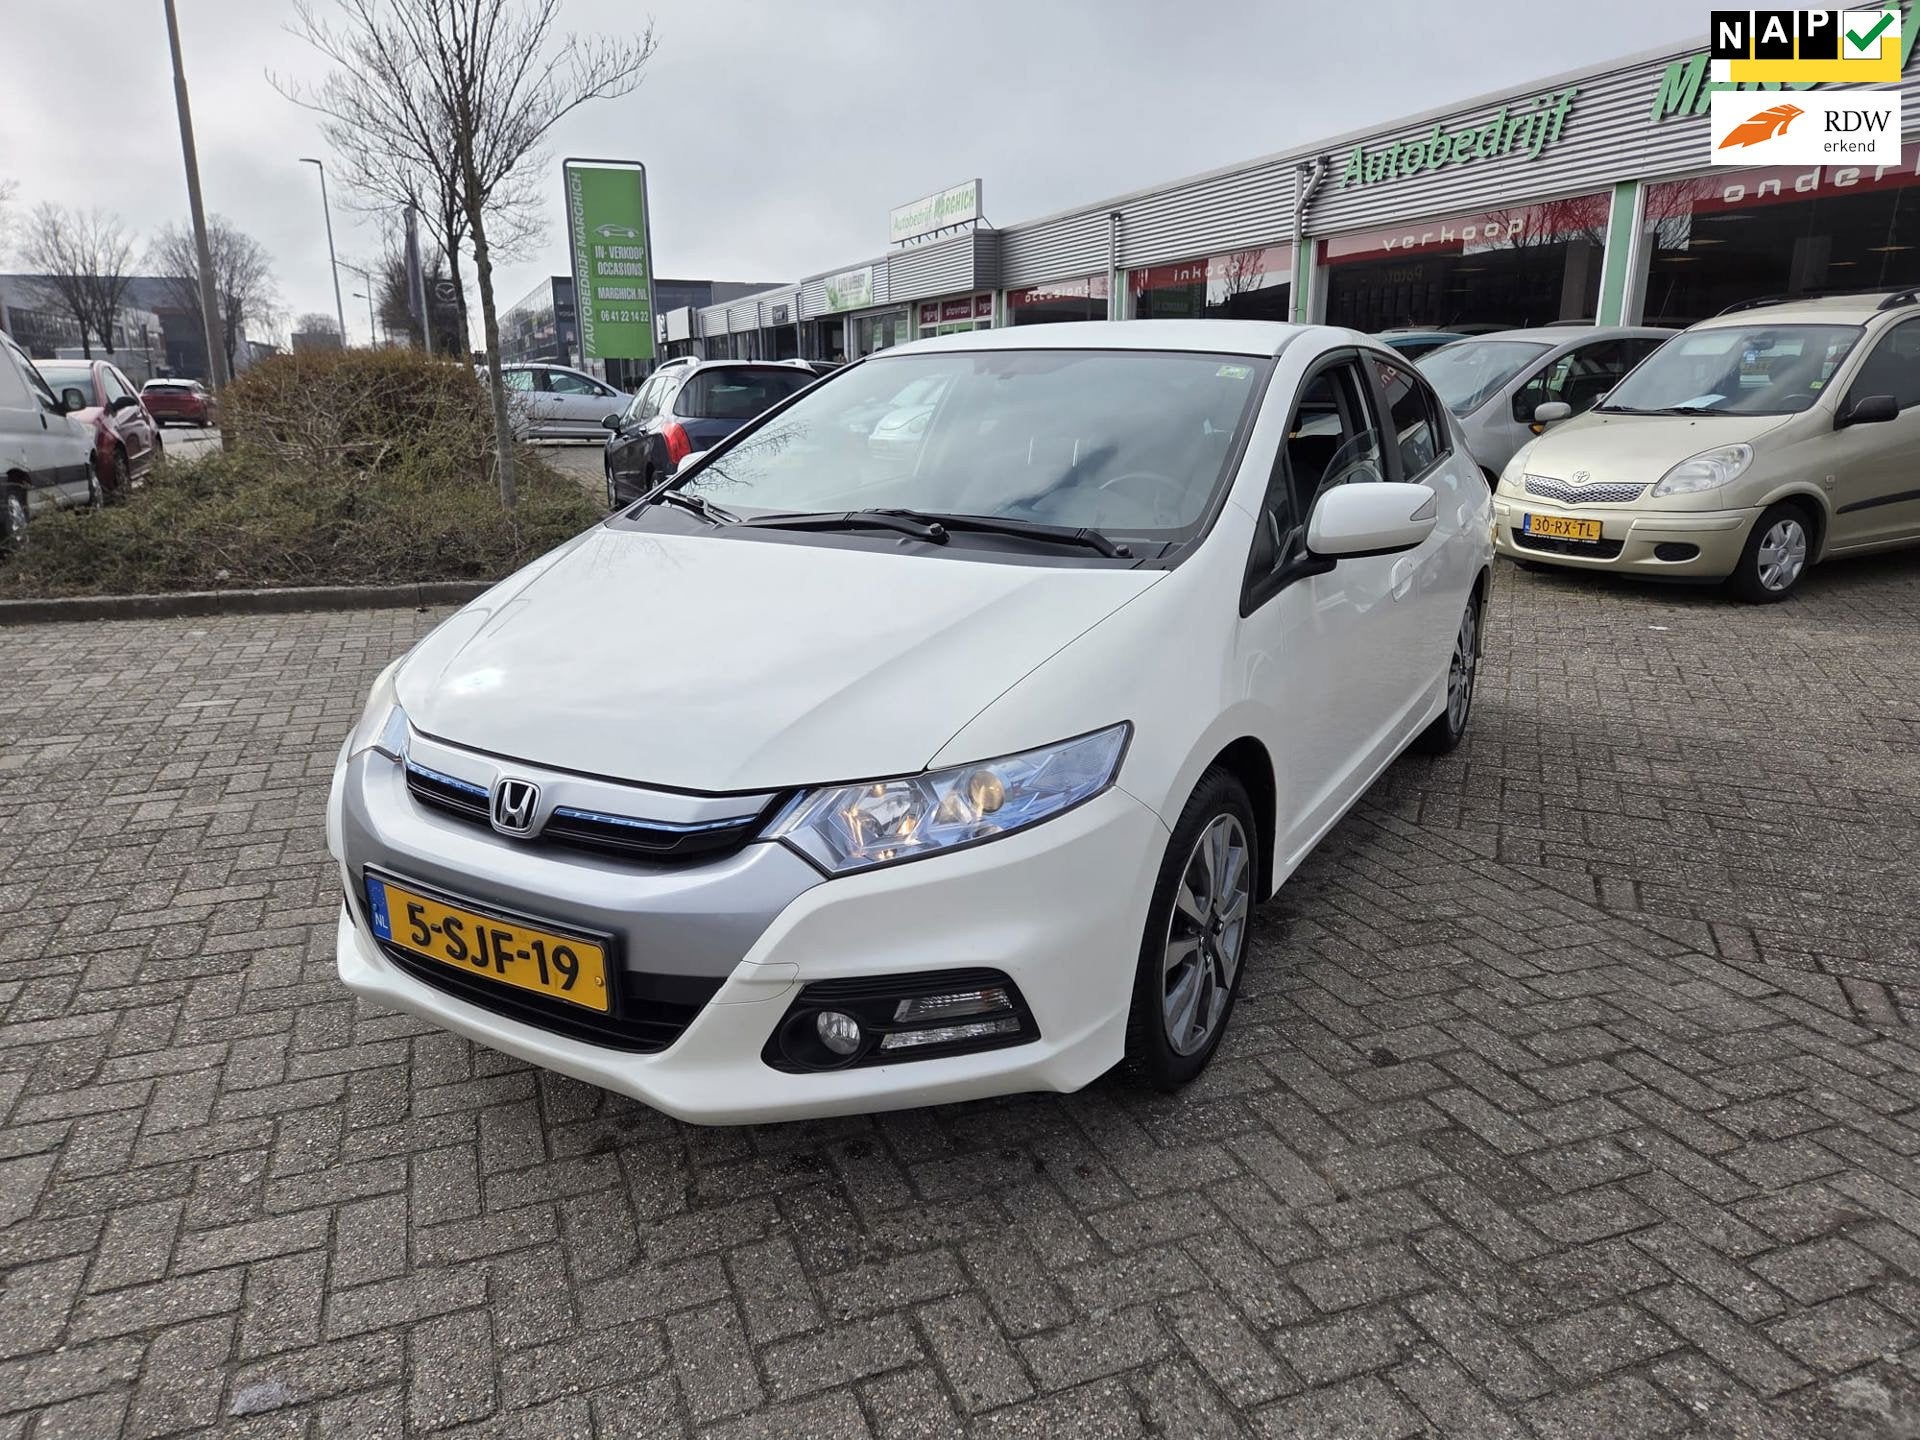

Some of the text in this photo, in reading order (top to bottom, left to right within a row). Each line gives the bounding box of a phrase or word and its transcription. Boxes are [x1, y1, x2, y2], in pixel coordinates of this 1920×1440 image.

[1337, 86, 1580, 189] Autobedrijf
[570, 171, 585, 248] MARGHICH
[1382, 217, 1524, 252] verkoop
[608, 245, 644, 260] VERKOOP
[597, 261, 643, 277] OCCASIONS
[1173, 260, 1241, 283] inkoop
[597, 287, 649, 301] MARGHICH.NL
[1024, 284, 1091, 304] occasions
[600, 310, 649, 323] 06 41 22 14 22
[1534, 518, 1594, 537] 30-RX-TL
[374, 911, 389, 929] NL
[406, 902, 580, 991] 5-SJF-19
